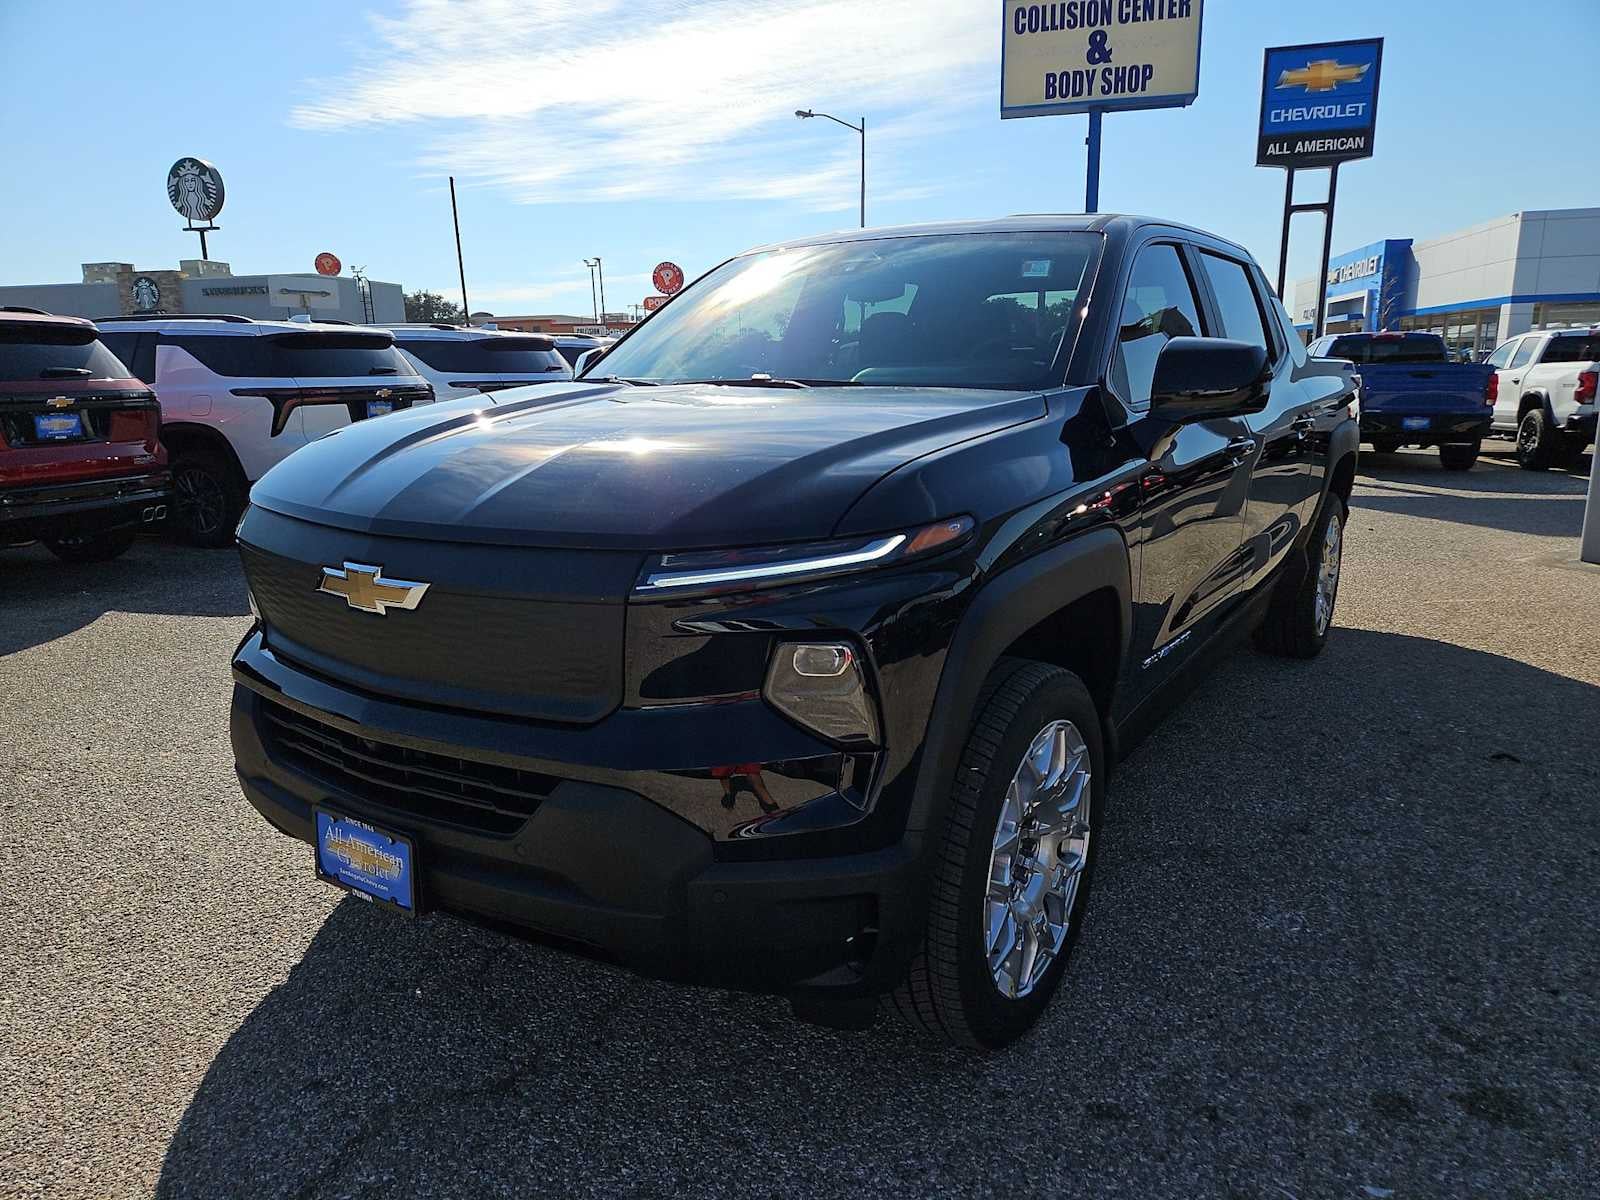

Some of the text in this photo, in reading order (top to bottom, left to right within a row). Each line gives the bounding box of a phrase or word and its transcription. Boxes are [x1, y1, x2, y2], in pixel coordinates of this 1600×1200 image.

[1014, 0, 1191, 34] COLLISION CENTER
[1086, 29, 1113, 65] &
[1045, 64, 1153, 100] BODY SHOP
[1271, 103, 1367, 123] CHEVROLET
[1266, 136, 1365, 155] ALL AMERICAN
[1339, 255, 1379, 283] CHEVROLET
[325, 824, 404, 869] All American
